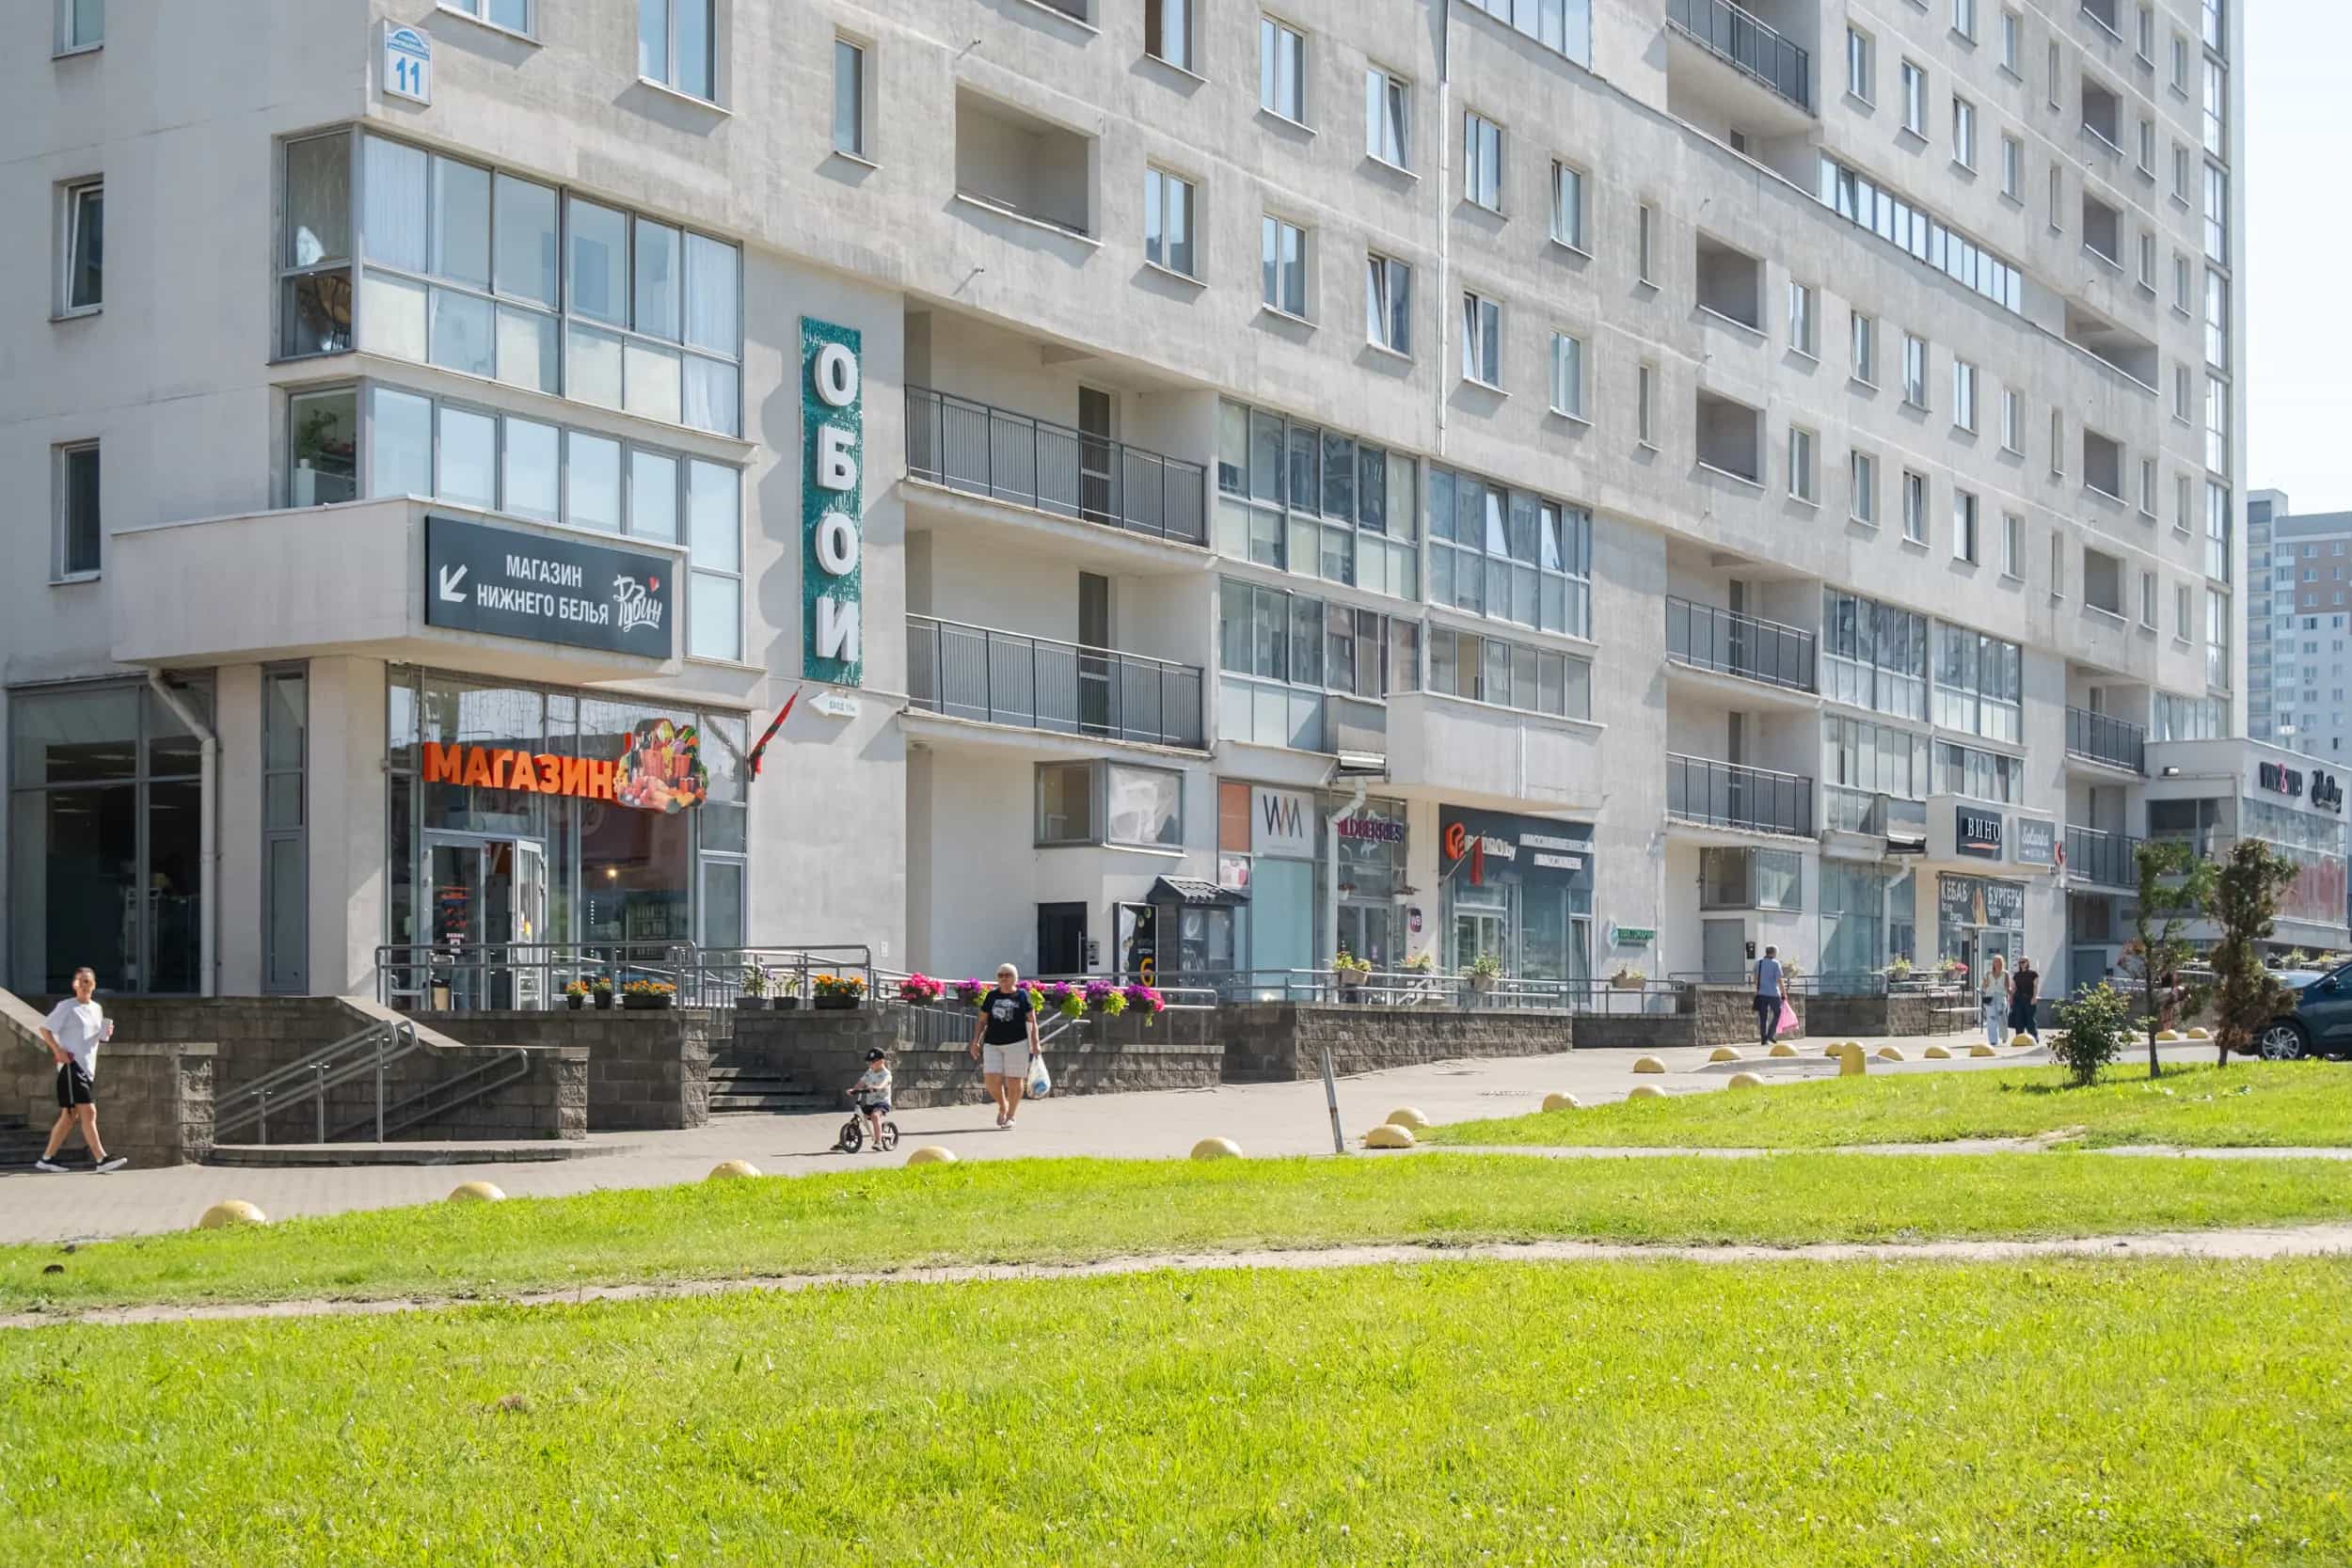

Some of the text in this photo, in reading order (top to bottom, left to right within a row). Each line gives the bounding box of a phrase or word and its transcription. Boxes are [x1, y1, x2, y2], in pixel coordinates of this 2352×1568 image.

[396, 56, 420, 95] 11
[815, 342, 859, 663] ОБОИ
[505, 554, 583, 588] МАГАЗИН
[477, 583, 610, 625] НИЖНЕГО БЕЛЬЯ
[422, 740, 616, 800] МАГАЗИН
[1967, 816, 2001, 842] ВИНО
[1941, 879, 1968, 903] КЕБАБ
[1987, 886, 2023, 908] БУРГЕРЫ
